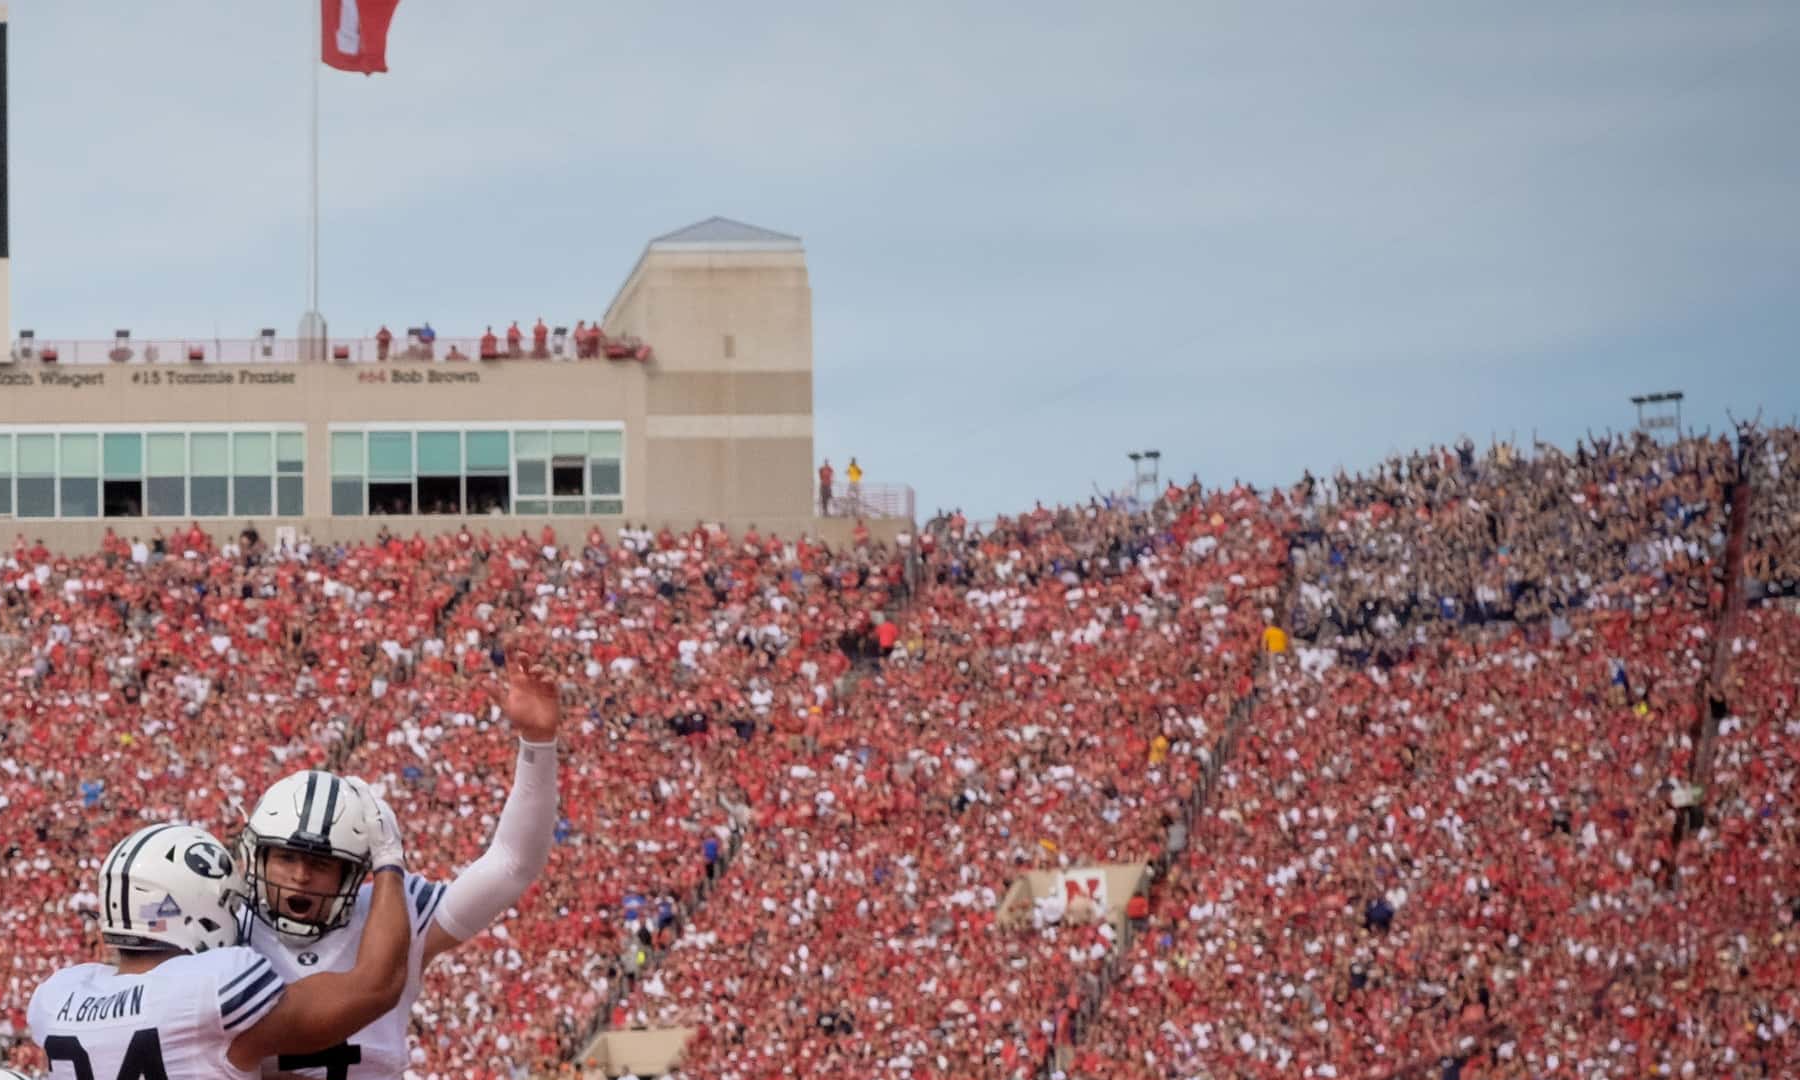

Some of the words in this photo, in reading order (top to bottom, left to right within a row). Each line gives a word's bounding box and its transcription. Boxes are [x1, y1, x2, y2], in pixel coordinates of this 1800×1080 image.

[39, 370, 105, 388] Wiegert
[131, 370, 161, 385] #15
[166, 370, 235, 386] Tommie
[239, 369, 296, 385] Frazier
[392, 369, 423, 384] Bob
[428, 369, 481, 384] Brown
